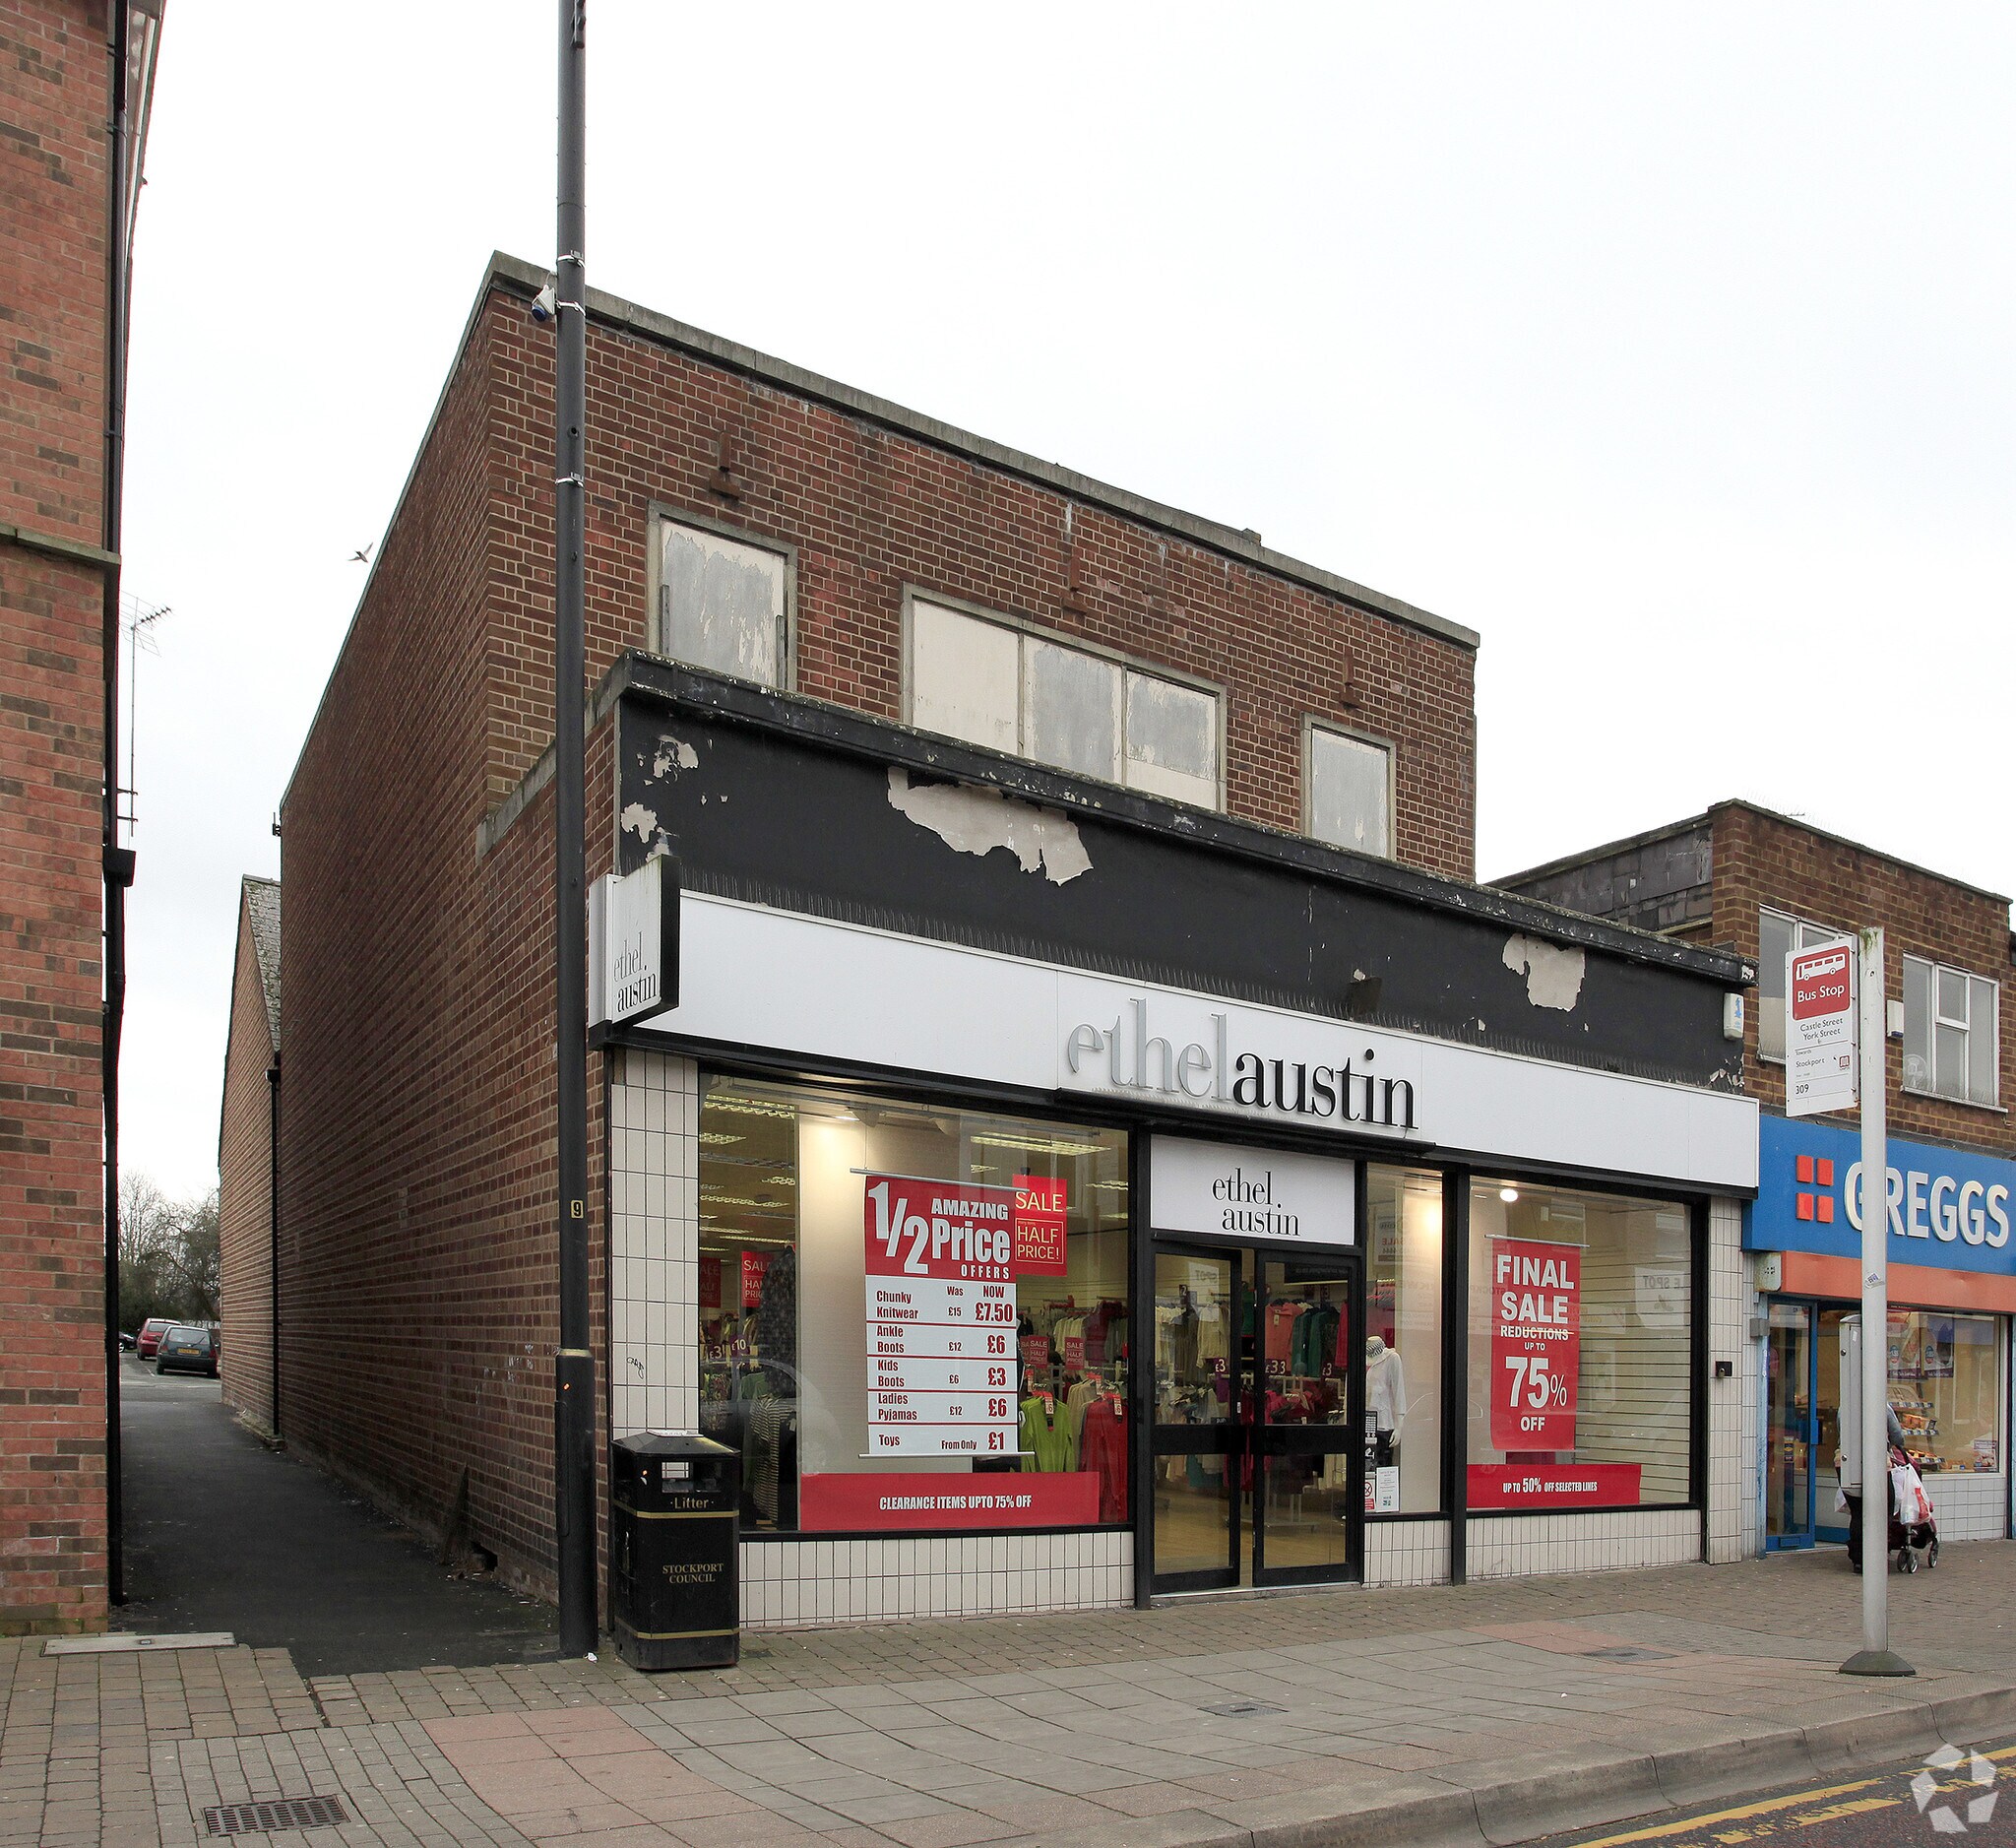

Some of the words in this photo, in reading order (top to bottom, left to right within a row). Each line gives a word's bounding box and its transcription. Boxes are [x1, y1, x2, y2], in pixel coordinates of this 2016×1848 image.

[613, 930, 643, 983] ethel
[617, 965, 657, 1012] austin
[1796, 989, 1817, 1003] Bus
[1819, 985, 1845, 1001] Stop
[1799, 1020, 1821, 1033] Castle
[1821, 1017, 1844, 1029] Street
[1802, 1031, 1819, 1042] York
[1819, 1027, 1841, 1039] Street
[1796, 1056, 1825, 1068] Stockport
[1796, 1083, 1809, 1095] 309
[1212, 1167, 1274, 1206] ethel
[574, 1201, 581, 1217] 9
[931, 1198, 1009, 1221] AMAZING
[1015, 1191, 1063, 1213] SALE
[868, 1181, 928, 1274] 1/2
[931, 1218, 1011, 1265] Price
[1222, 1203, 1301, 1237] austin
[1017, 1226, 1058, 1244] HALF
[1017, 1243, 1059, 1260] PRICE!
[961, 1264, 1010, 1280] OFFERS
[1496, 1253, 1575, 1290] FINAL
[876, 1290, 912, 1305] Chunky
[947, 1285, 964, 1297] Was
[983, 1285, 1005, 1299] NOW
[876, 1306, 918, 1319] Knitwear
[948, 1306, 962, 1317] £15
[975, 1302, 1014, 1322] £7.50
[1501, 1291, 1568, 1324] SALE
[876, 1325, 904, 1338] Ankle
[1500, 1325, 1569, 1341] REDUCTIONS
[731, 1338, 746, 1352] £10
[877, 1342, 905, 1354] Boots
[948, 1342, 962, 1352] £12
[986, 1334, 1006, 1355] £6
[1524, 1341, 1535, 1351] UP
[1536, 1342, 1545, 1351] TO
[877, 1360, 899, 1371] Kids
[1215, 1358, 1226, 1373] £3
[877, 1375, 905, 1387] Boots
[949, 1374, 960, 1384] £6
[987, 1367, 1006, 1386] £3
[1505, 1356, 1567, 1409] 75%
[878, 1393, 909, 1405] Ladies
[878, 1409, 917, 1422] Pyjamas
[949, 1406, 963, 1416] £12
[987, 1398, 1007, 1418] £6
[1520, 1416, 1545, 1432] OFF
[878, 1434, 901, 1447] Toys
[941, 1439, 960, 1450] From
[961, 1439, 977, 1450] Only
[987, 1432, 1005, 1450] £1
[1502, 1482, 1512, 1494] UP
[1512, 1482, 1521, 1494] TO
[1522, 1477, 1543, 1494] 50%
[1544, 1482, 1555, 1493] OFF
[1555, 1481, 1582, 1493] SELECTED
[1582, 1481, 1598, 1493] LINES
[674, 1497, 710, 1509] Litter
[879, 1497, 935, 1510] CLEARANCE
[936, 1496, 967, 1509] ITEMS
[994, 1495, 1015, 1508] 75%
[1016, 1495, 1033, 1508] OFF
[662, 1562, 724, 1574] STOCKPORT
[668, 1573, 716, 1584] COUNCIL
